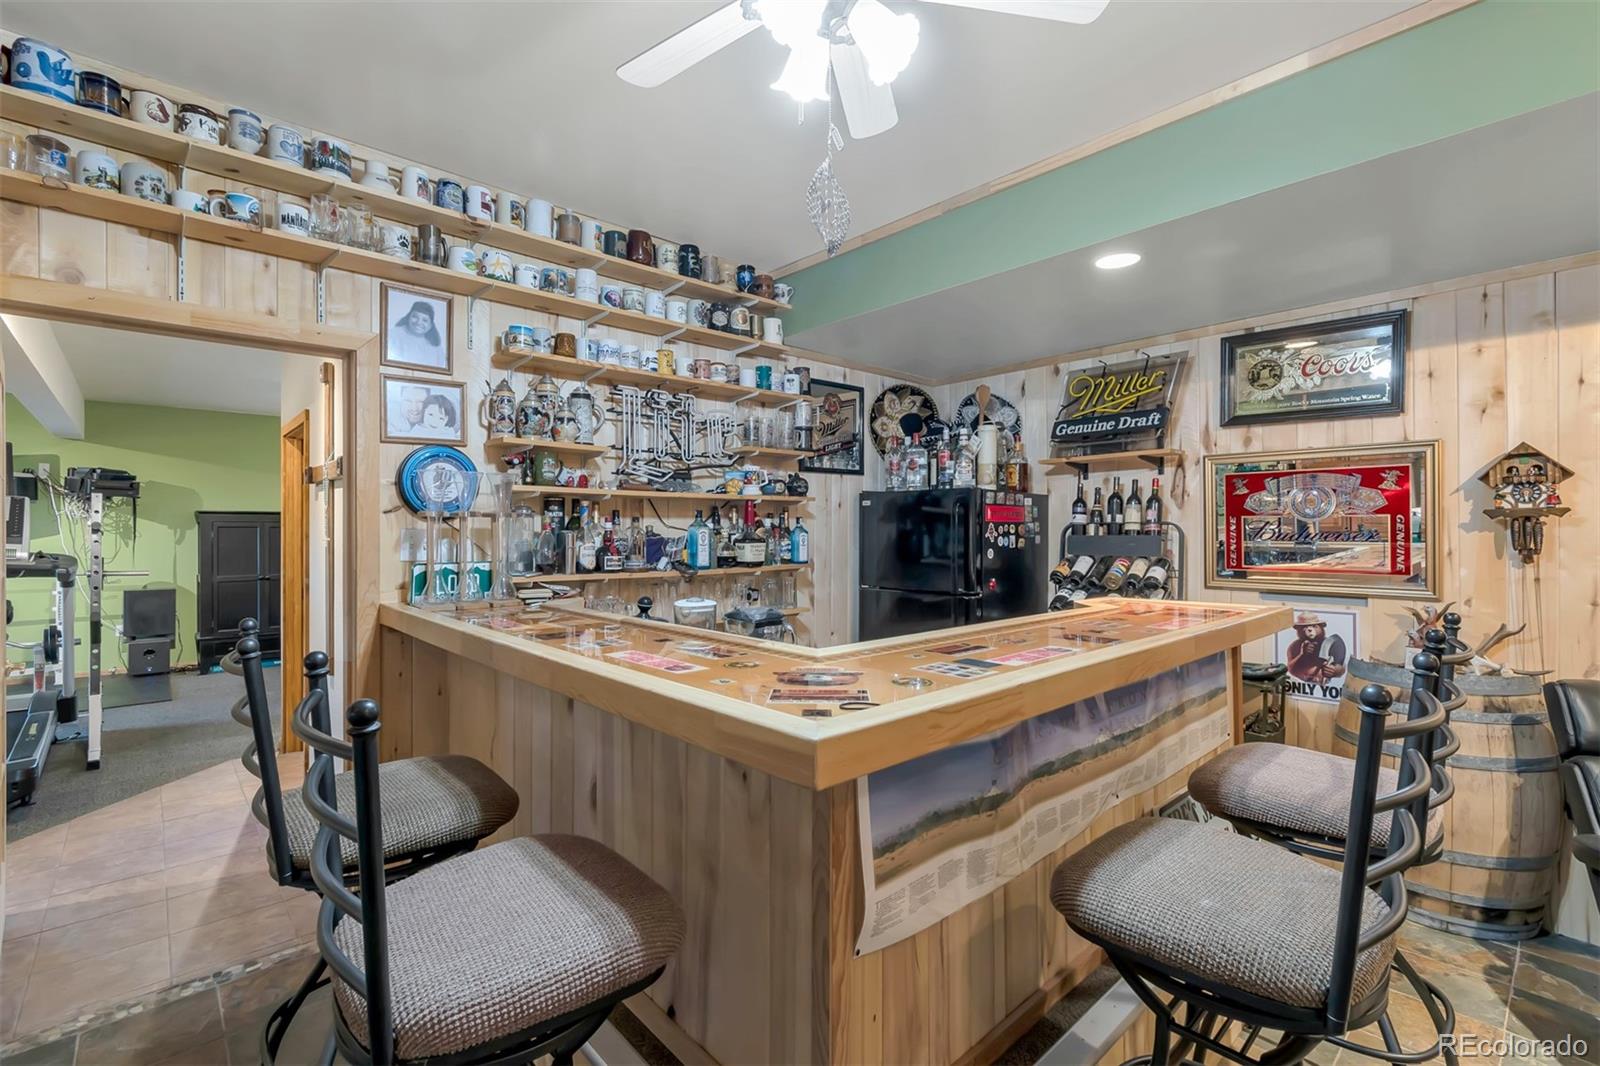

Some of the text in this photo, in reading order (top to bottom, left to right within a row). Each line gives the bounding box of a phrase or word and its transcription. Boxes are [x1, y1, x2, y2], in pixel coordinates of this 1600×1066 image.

[1300, 351, 1375, 378] Coors
[1069, 370, 1165, 411] Miller
[817, 416, 850, 437] Miller
[1055, 412, 1162, 436] Genuine Draft
[1230, 515, 1238, 567] GENUINE
[1246, 517, 1382, 542] Budweiser
[1395, 514, 1406, 573] GENUINE
[1284, 681, 1316, 696] ONLY
